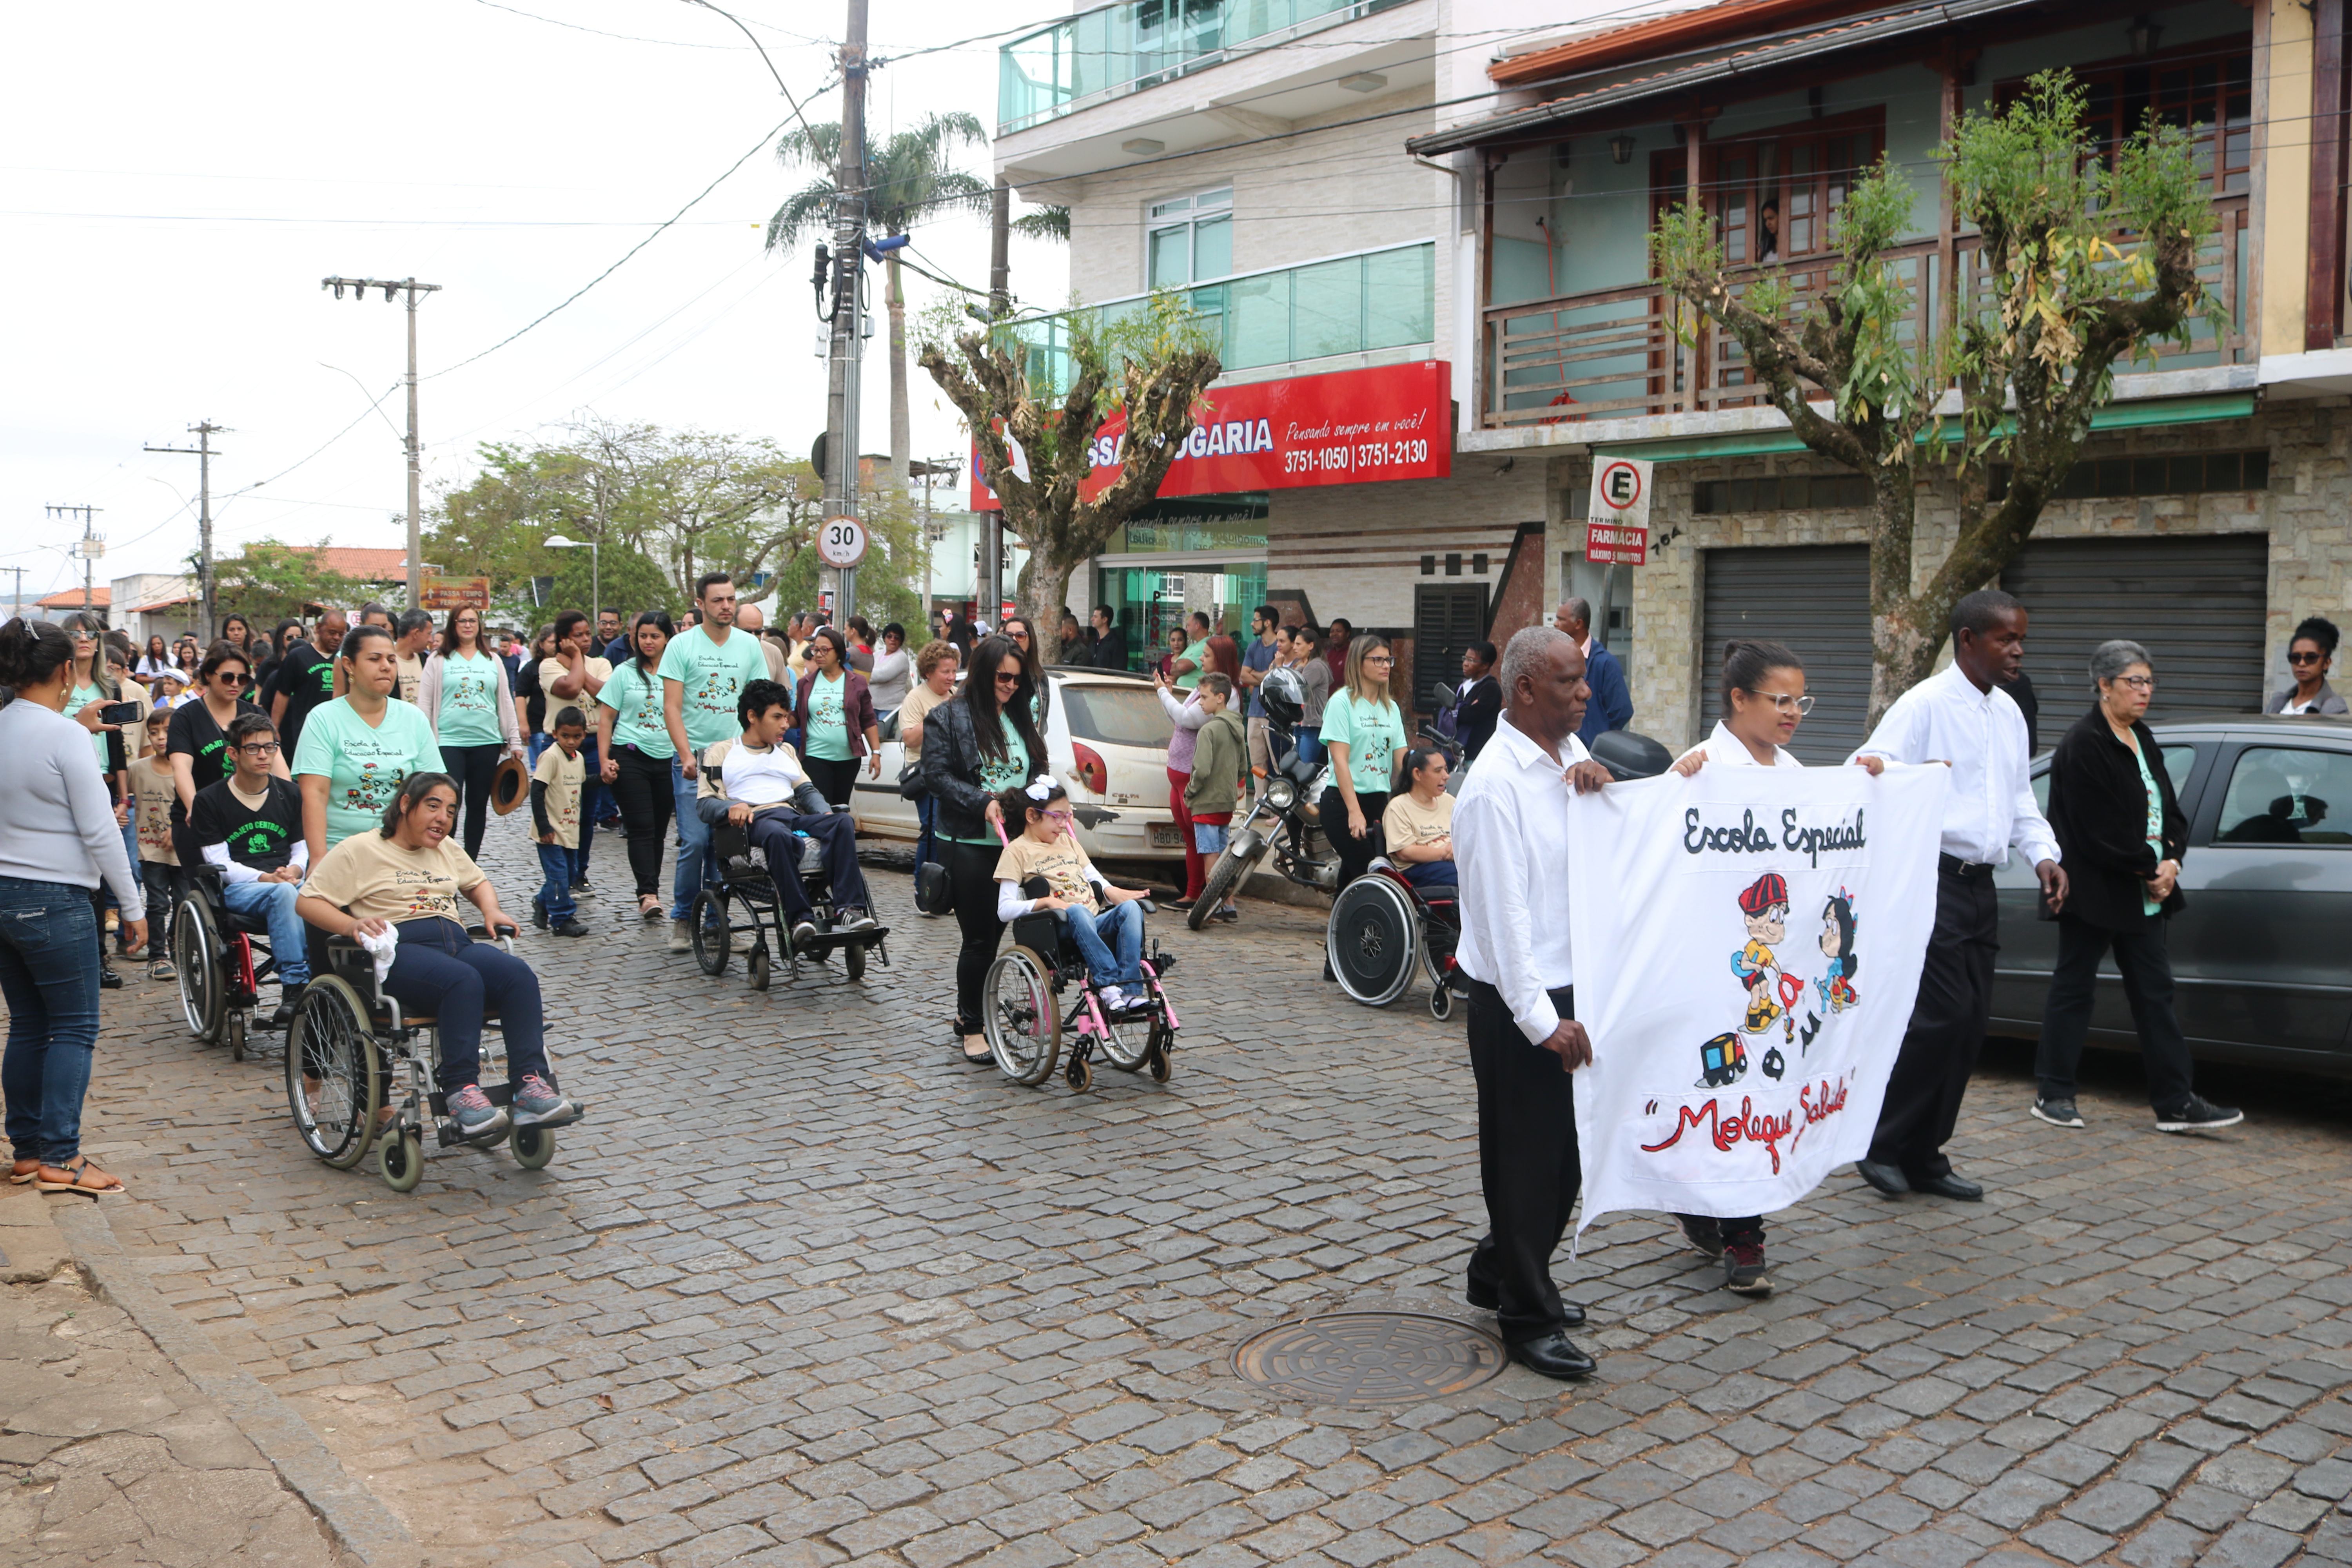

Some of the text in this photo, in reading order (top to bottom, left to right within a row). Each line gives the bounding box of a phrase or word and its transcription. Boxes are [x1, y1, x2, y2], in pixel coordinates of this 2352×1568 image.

[1286, 408, 1427, 442] Pensando sempre em você!
[1285, 438, 1428, 473] 3751-1050 3751-2130
[1612, 472, 1631, 499] E
[830, 526, 854, 545] 30
[1591, 528, 1643, 547] FARMÁCIA
[1590, 547, 1642, 563] MÁXIMO 5 MINUTOS
[226, 822, 254, 843] PROJETO
[254, 821, 279, 832] CENTRO
[1684, 808, 1866, 869] Escola Especial
